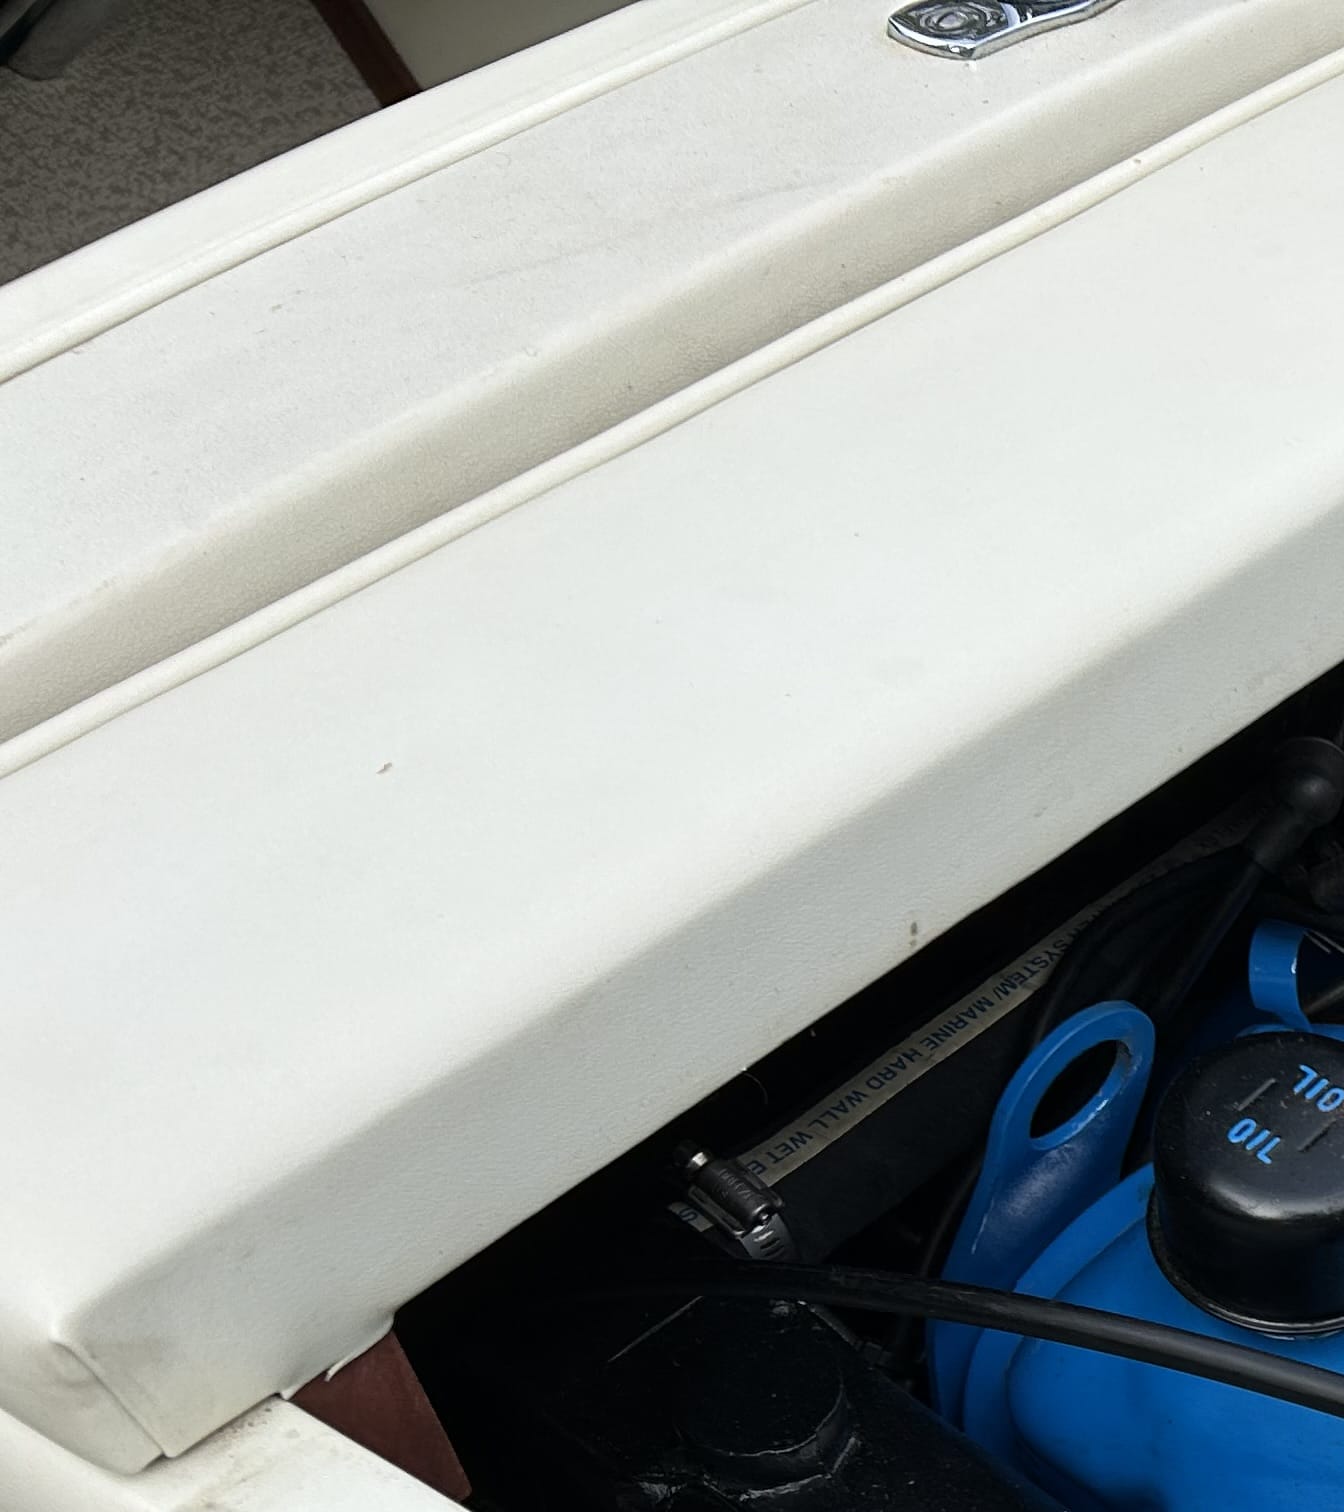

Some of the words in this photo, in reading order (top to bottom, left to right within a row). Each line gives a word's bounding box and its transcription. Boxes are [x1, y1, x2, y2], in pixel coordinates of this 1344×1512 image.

[923, 995, 993, 1052] MARINE
[866, 1046, 922, 1090] HARD
[811, 1087, 866, 1129] WALL
[766, 1131, 808, 1165] WET
[1226, 1117, 1280, 1164] OIL
